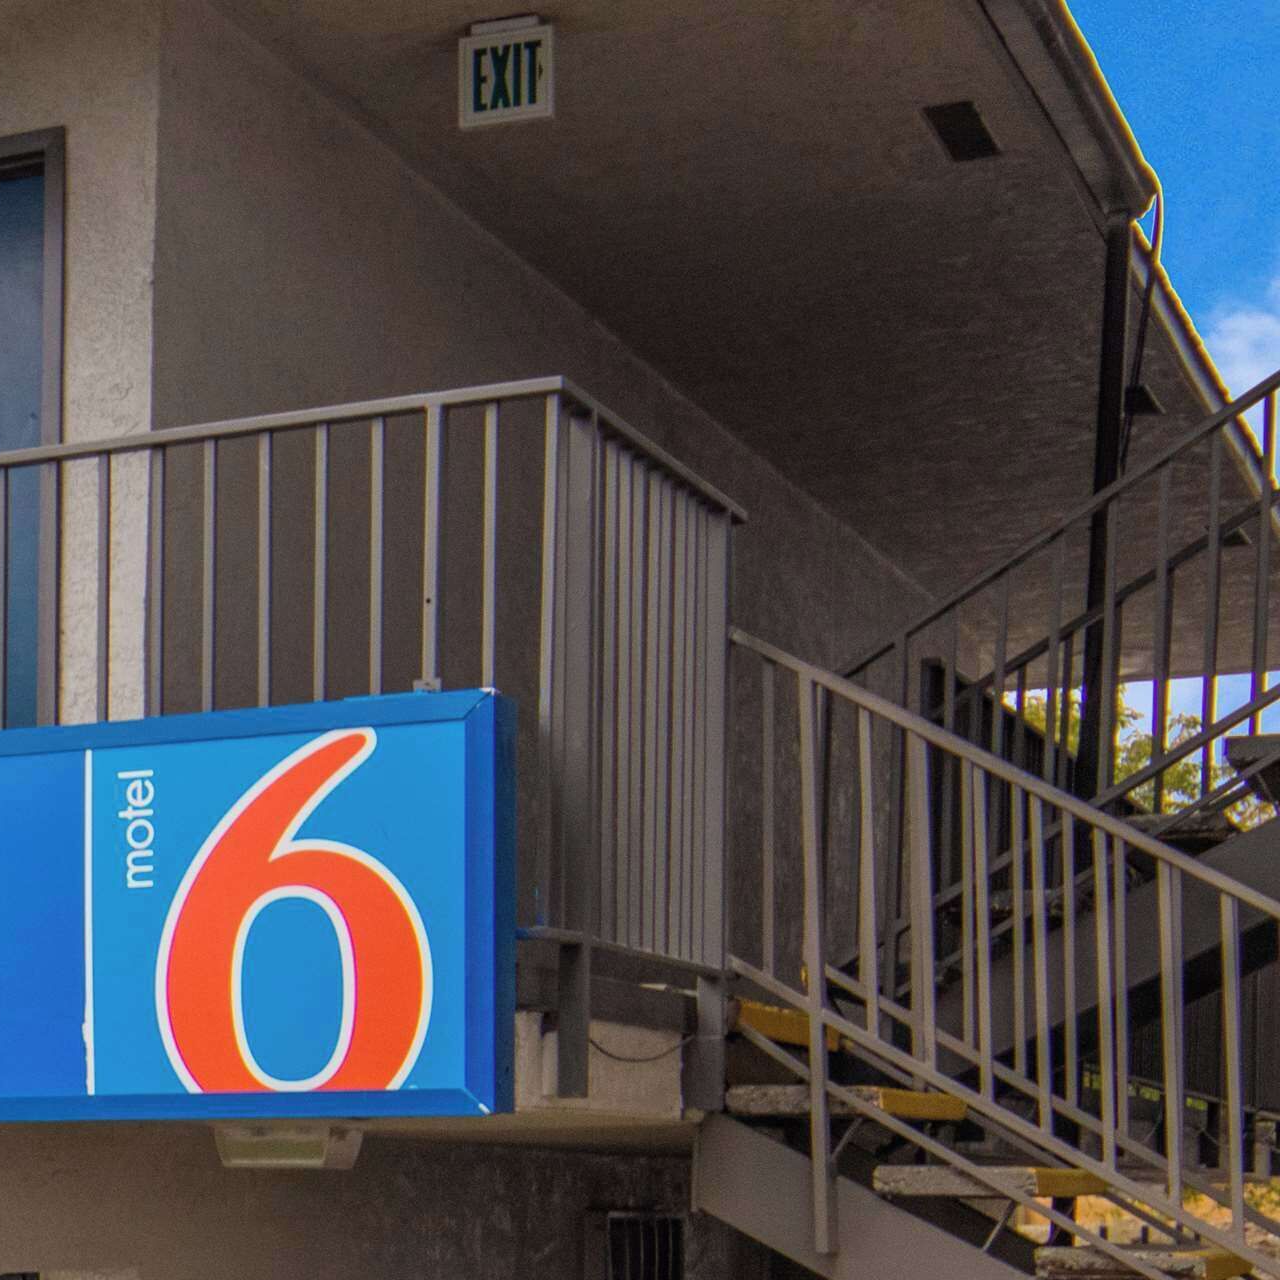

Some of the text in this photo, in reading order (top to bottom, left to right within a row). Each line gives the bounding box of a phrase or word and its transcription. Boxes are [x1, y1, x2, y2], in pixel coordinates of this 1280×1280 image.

[472, 40, 542, 113] EXIT
[117, 726, 434, 1095] motel 6
